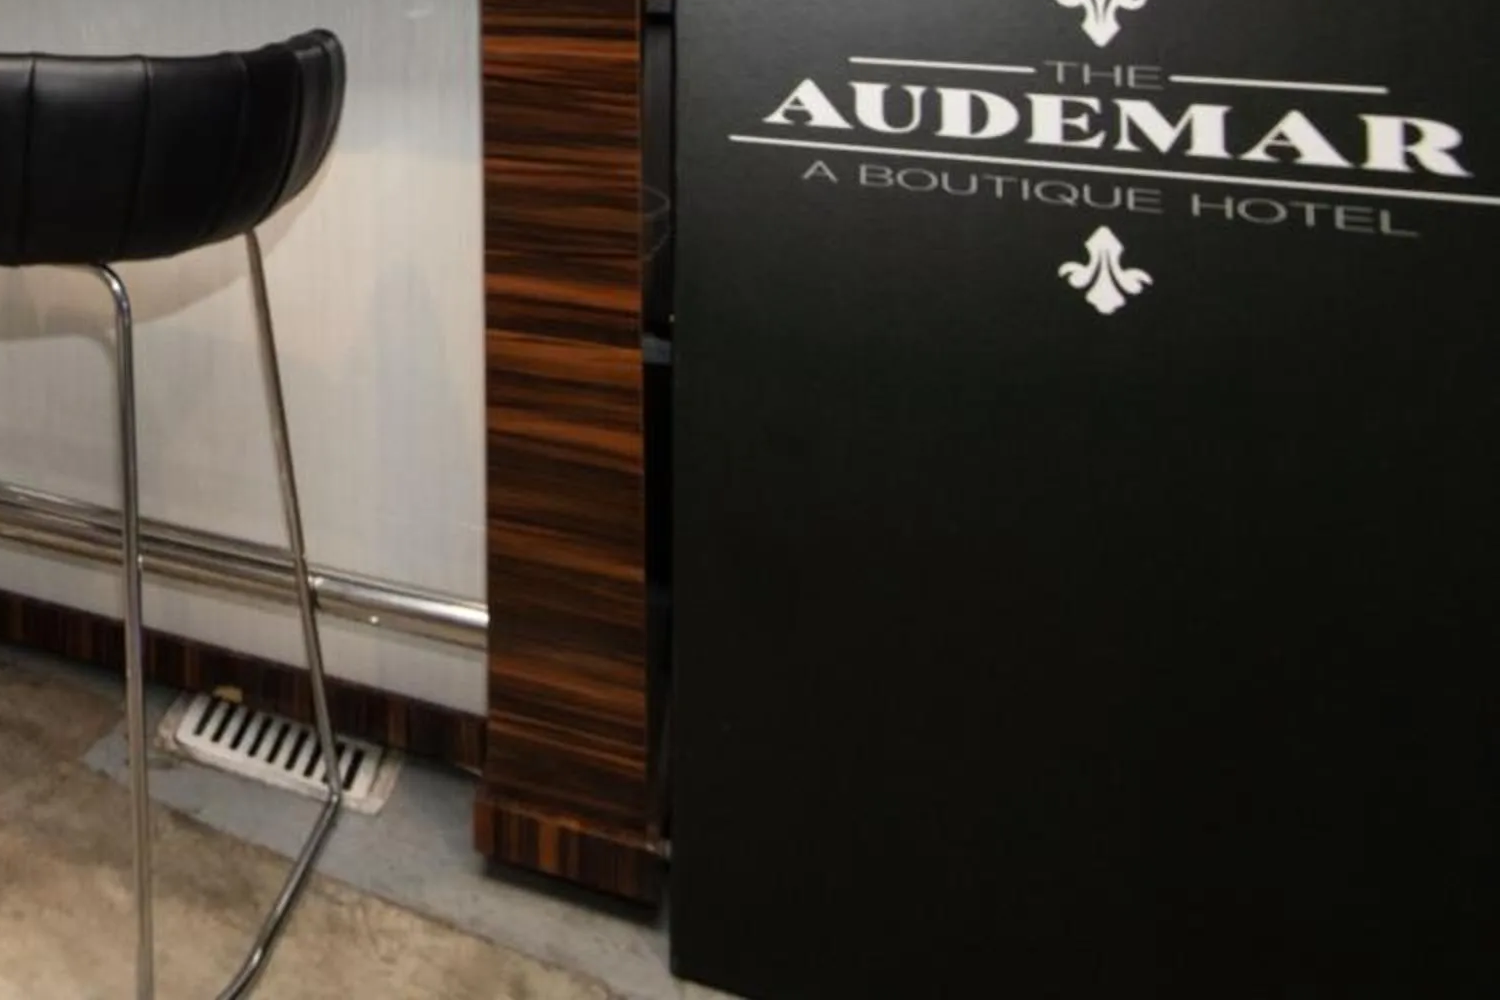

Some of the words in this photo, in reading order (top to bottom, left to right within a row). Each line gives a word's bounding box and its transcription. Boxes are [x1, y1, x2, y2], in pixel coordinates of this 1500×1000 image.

[1044, 59, 1163, 90] THE
[764, 77, 1474, 178] AUDEMAR
[801, 159, 840, 183] A
[860, 163, 1163, 215] BOUTIQUE
[1192, 193, 1419, 238] HOTEL
